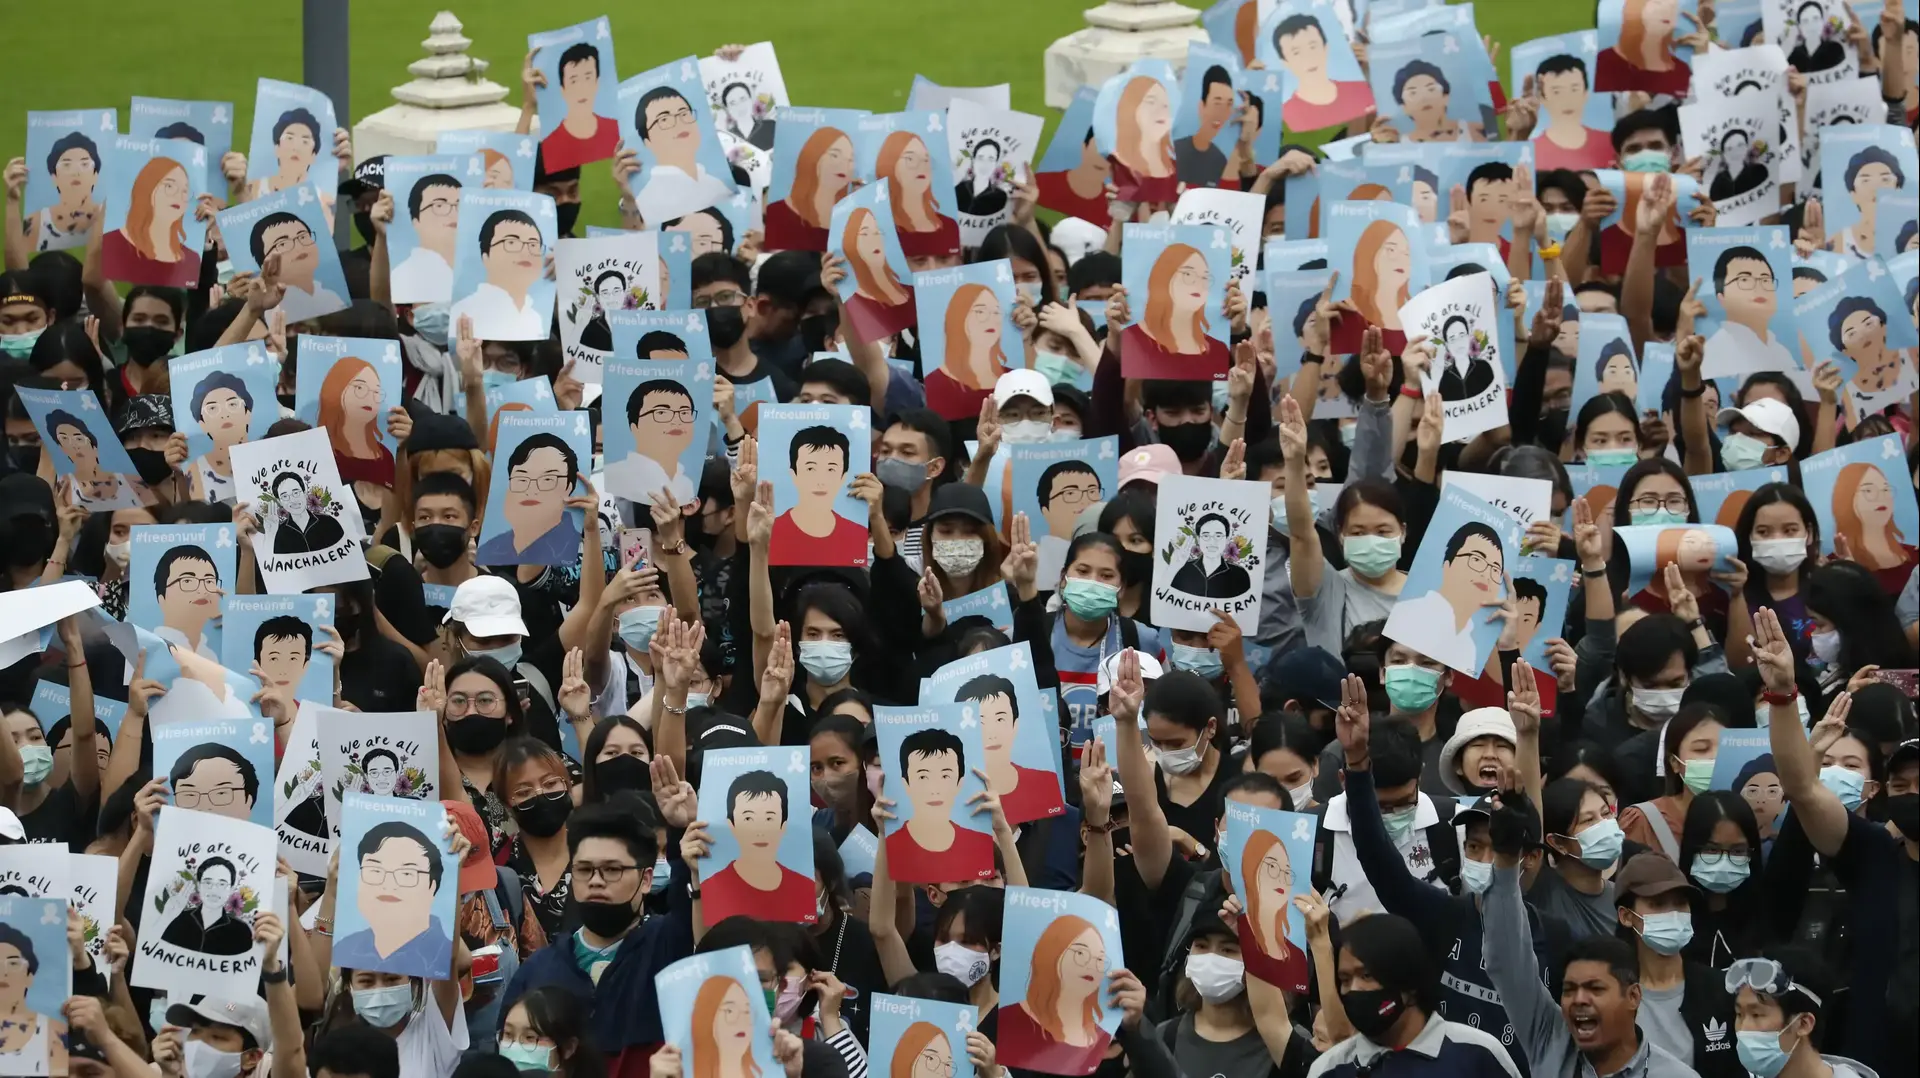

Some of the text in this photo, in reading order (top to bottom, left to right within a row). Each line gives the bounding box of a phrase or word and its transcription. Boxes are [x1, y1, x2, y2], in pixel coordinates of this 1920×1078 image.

[1808, 65, 1854, 84] ALERM
[1716, 180, 1776, 215] NCHALERM
[598, 258, 618, 270] are
[624, 260, 644, 275] all
[1441, 303, 1460, 315] are
[1464, 304, 1483, 319] all
[1443, 384, 1503, 418] NCHALERM
[251, 459, 318, 486] We are all
[1177, 499, 1251, 524] We are all
[1513, 505, 1533, 524] all
[135, 529, 207, 544] #freeอานนท์
[263, 538, 356, 574] WANCHALERM
[340, 739, 361, 755] We
[366, 735, 389, 748] are
[395, 739, 420, 757] all
[275, 824, 329, 854] ANCHAL
[178, 842, 260, 874] We are all
[29, 875, 52, 894] all
[75, 885, 98, 904] all
[1008, 890, 1068, 914] #freeรุ้ง
[140, 941, 258, 973] WANCHALERM
[1447, 975, 1471, 993] NEW
[873, 996, 921, 1020] #freeรุ้ง
